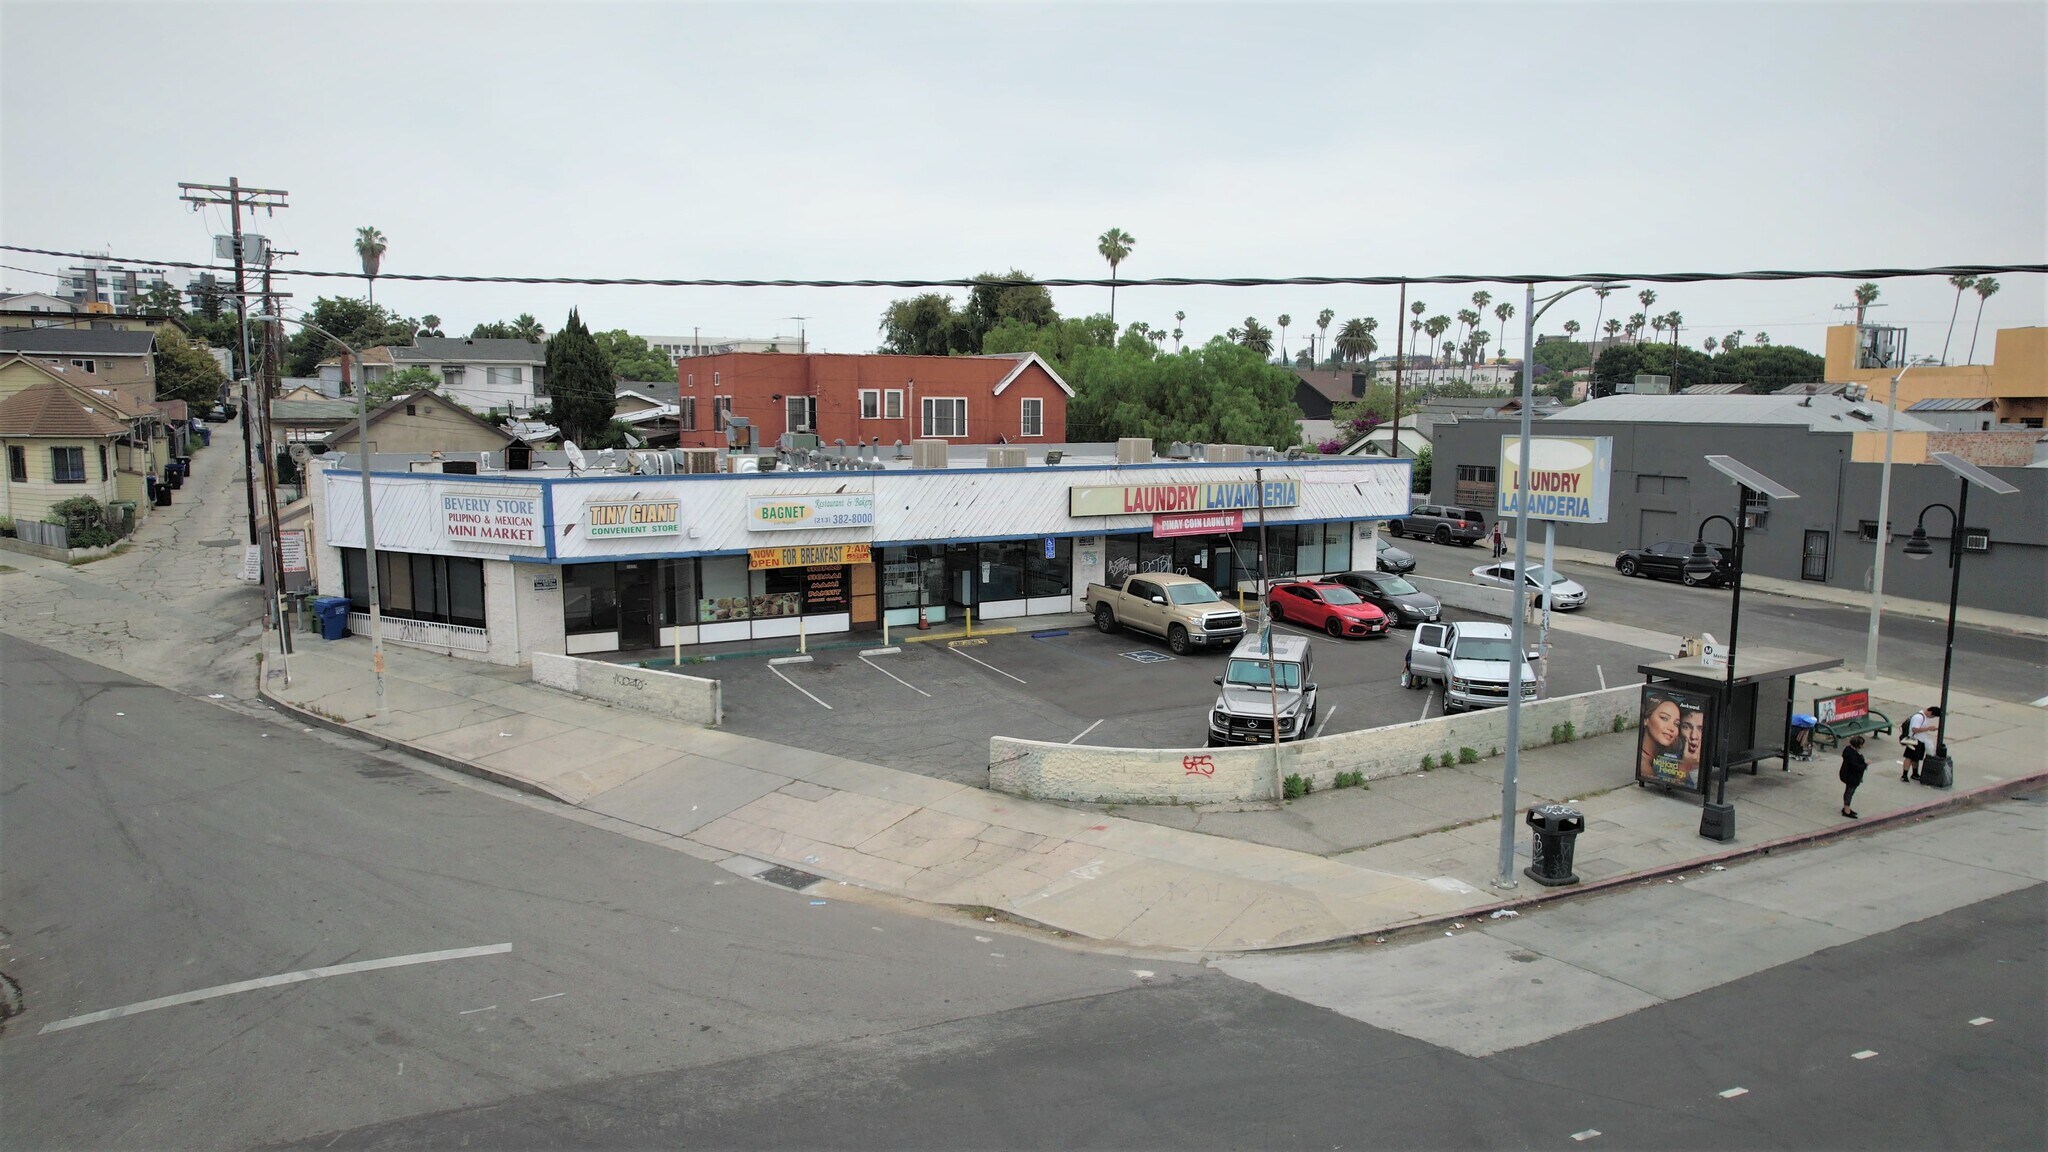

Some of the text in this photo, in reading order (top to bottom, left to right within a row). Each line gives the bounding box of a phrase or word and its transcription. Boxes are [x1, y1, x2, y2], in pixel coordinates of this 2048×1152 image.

[1513, 471, 1580, 493] LUNDRY
[444, 497, 534, 514] BEVERLY STORE
[814, 499, 844, 508] Restaurant
[854, 497, 873, 510] Bakery
[1124, 485, 1198, 513] LAUNDRY
[1502, 493, 1590, 518] LAANDERIA
[448, 513, 532, 526] PILIPINO & MEXICAN
[590, 503, 678, 525] TINY GIANT
[762, 506, 805, 519] BAGNET
[832, 513, 873, 524] 382-8000
[591, 524, 678, 535] CONVENIENT STORE
[1161, 515, 1235, 531] PINAY COIN LAUNDRY
[447, 525, 534, 540] MINI MARKET
[753, 550, 775, 558] NOW
[782, 549, 797, 565] FOR
[801, 546, 843, 564] BREAKFAST
[751, 559, 780, 568] OPEN
[1659, 766, 1686, 779] Feelings
